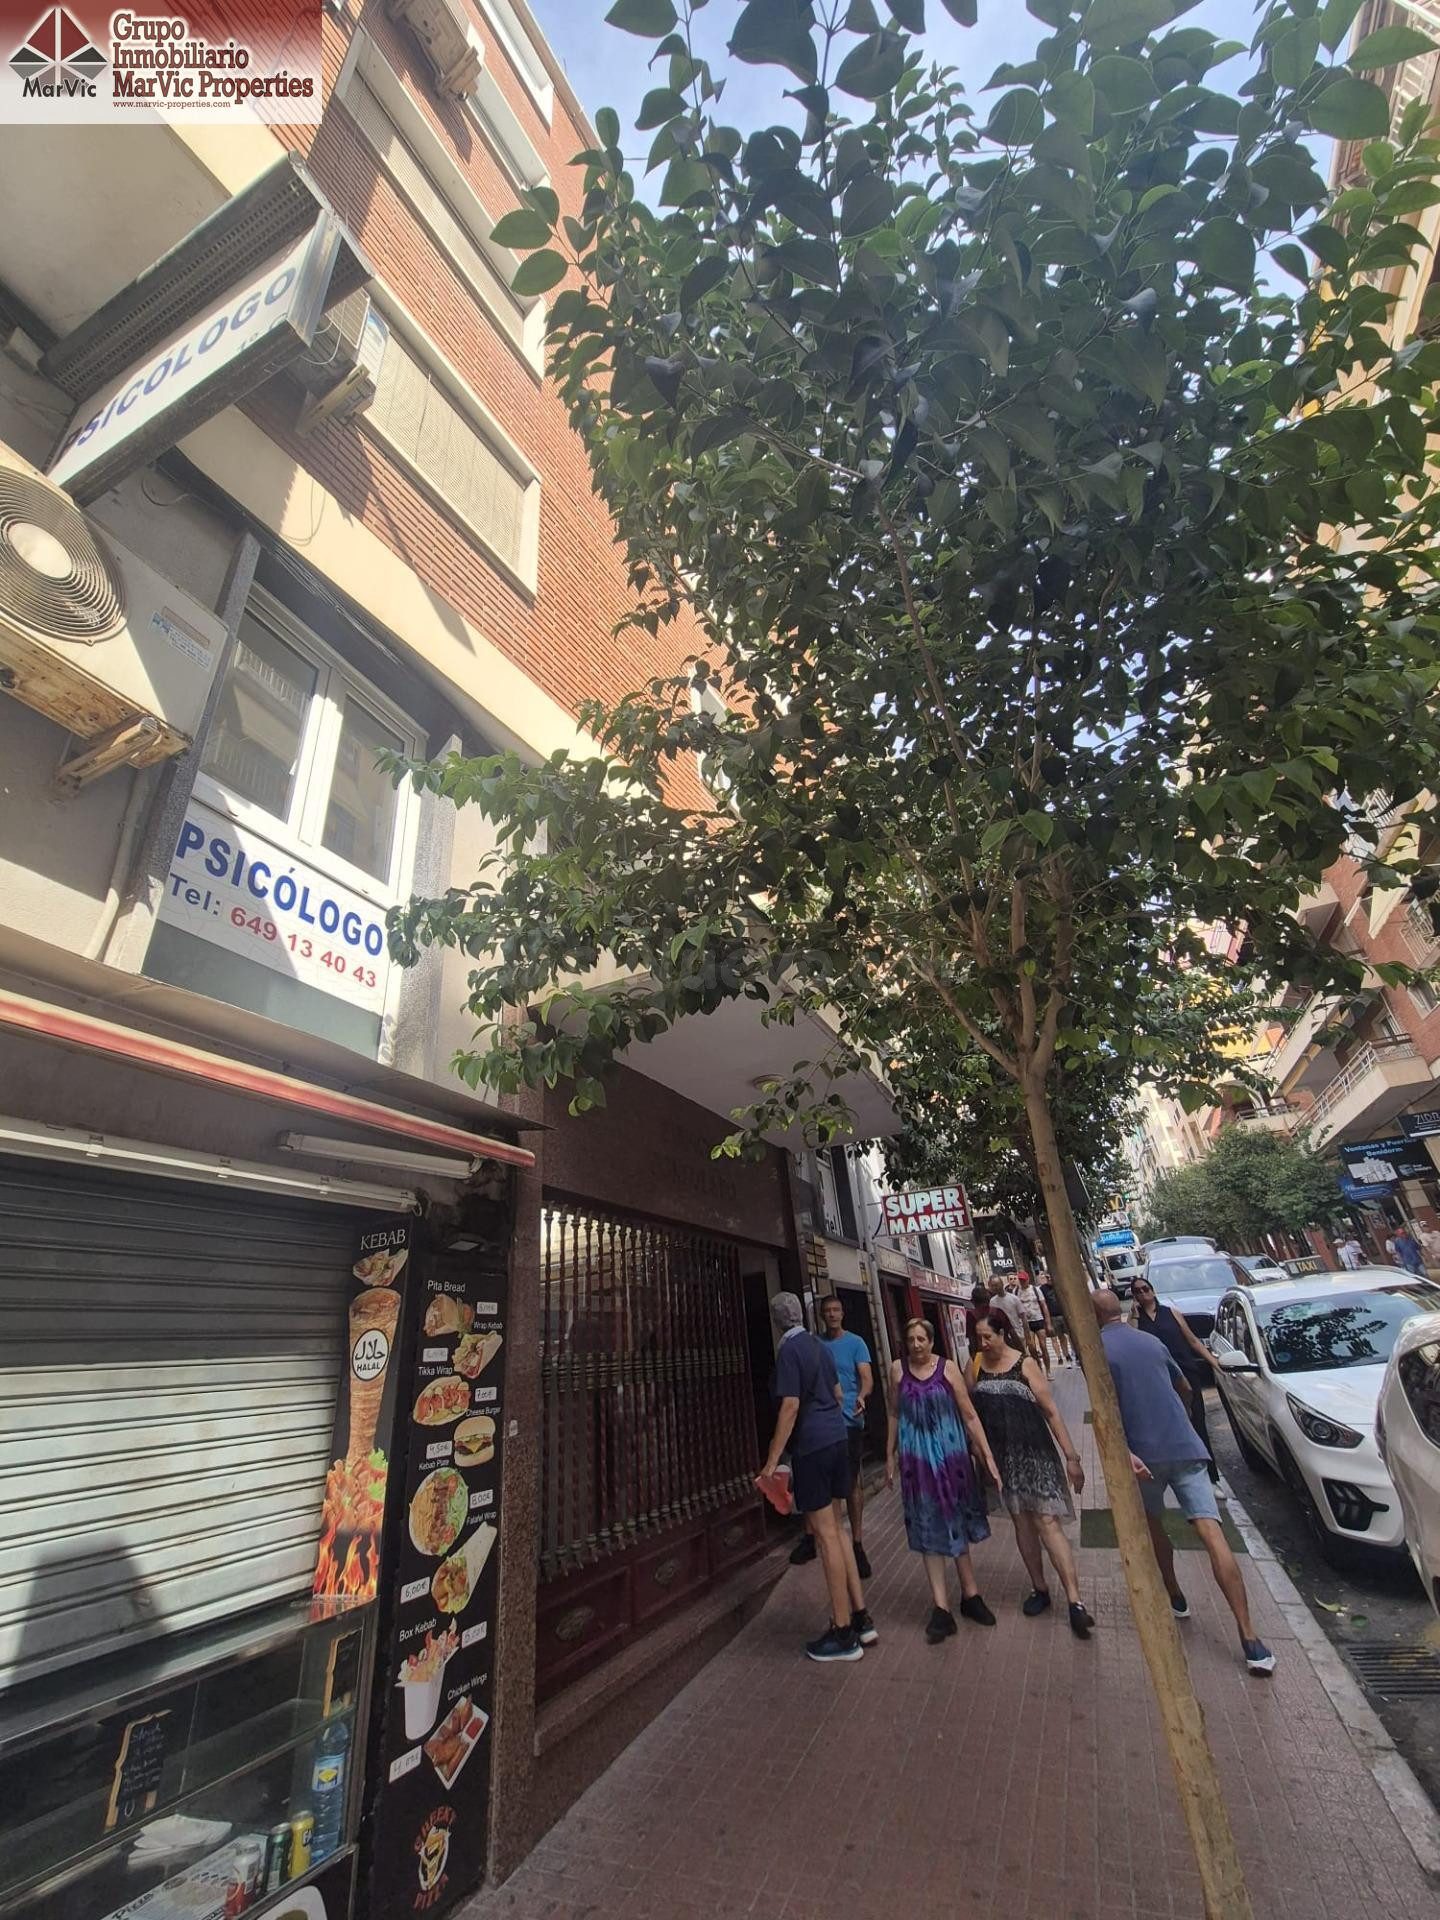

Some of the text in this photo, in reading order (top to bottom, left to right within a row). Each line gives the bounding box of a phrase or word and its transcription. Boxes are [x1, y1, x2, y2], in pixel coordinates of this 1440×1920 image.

[175, 821, 383, 956] PSICÓLOGO
[169, 873, 377, 988] Tel: 649 13 40 43
[885, 1188, 963, 1218] SUPER
[889, 1211, 966, 1236] MARKET
[361, 1229, 406, 1250] KEBAB
[993, 1258, 1013, 1268] POLO
[1296, 1260, 1317, 1272] TAXI
[427, 1280, 466, 1292] Pita Bread
[355, 1339, 385, 1360] حلال
[357, 1362, 380, 1371] HALAL
[418, 1366, 453, 1376] Tikka Wrap
[399, 1618, 437, 1642] Box Kebab
[447, 1674, 488, 1700] Chicken Wings
